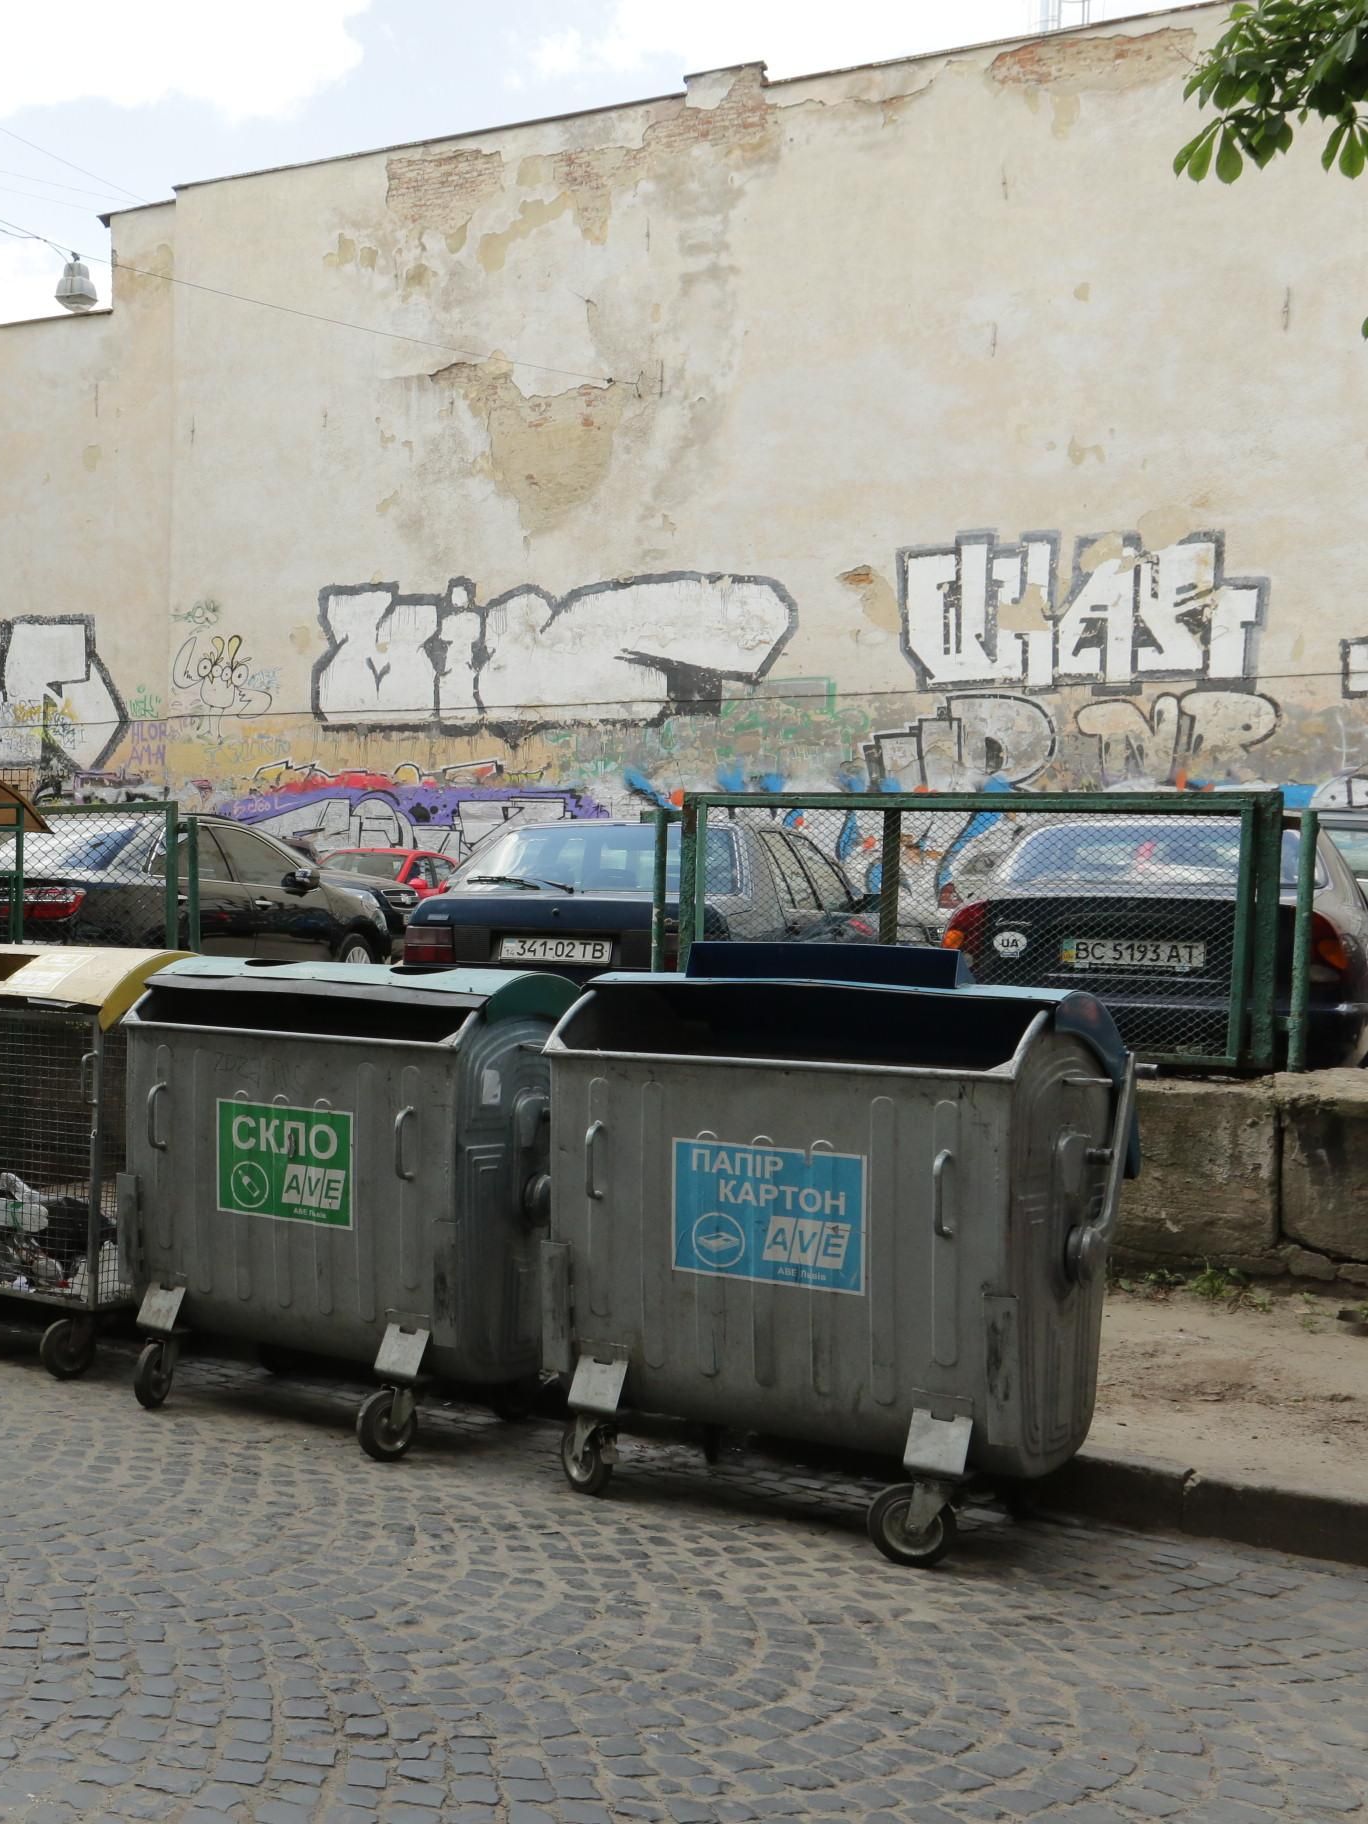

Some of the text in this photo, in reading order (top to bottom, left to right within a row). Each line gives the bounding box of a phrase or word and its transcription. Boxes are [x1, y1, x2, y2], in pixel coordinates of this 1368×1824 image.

[516, 939, 605, 960] 341-02 TB
[1000, 938, 1019, 949] UA
[1075, 941, 1199, 964] BC 5193 AT
[232, 1114, 338, 1160] СКЛО
[691, 1148, 784, 1179] ПАПІР
[284, 1173, 342, 1201] AVE
[719, 1178, 846, 1216] КАРТОН
[767, 1226, 845, 1259] AVE
